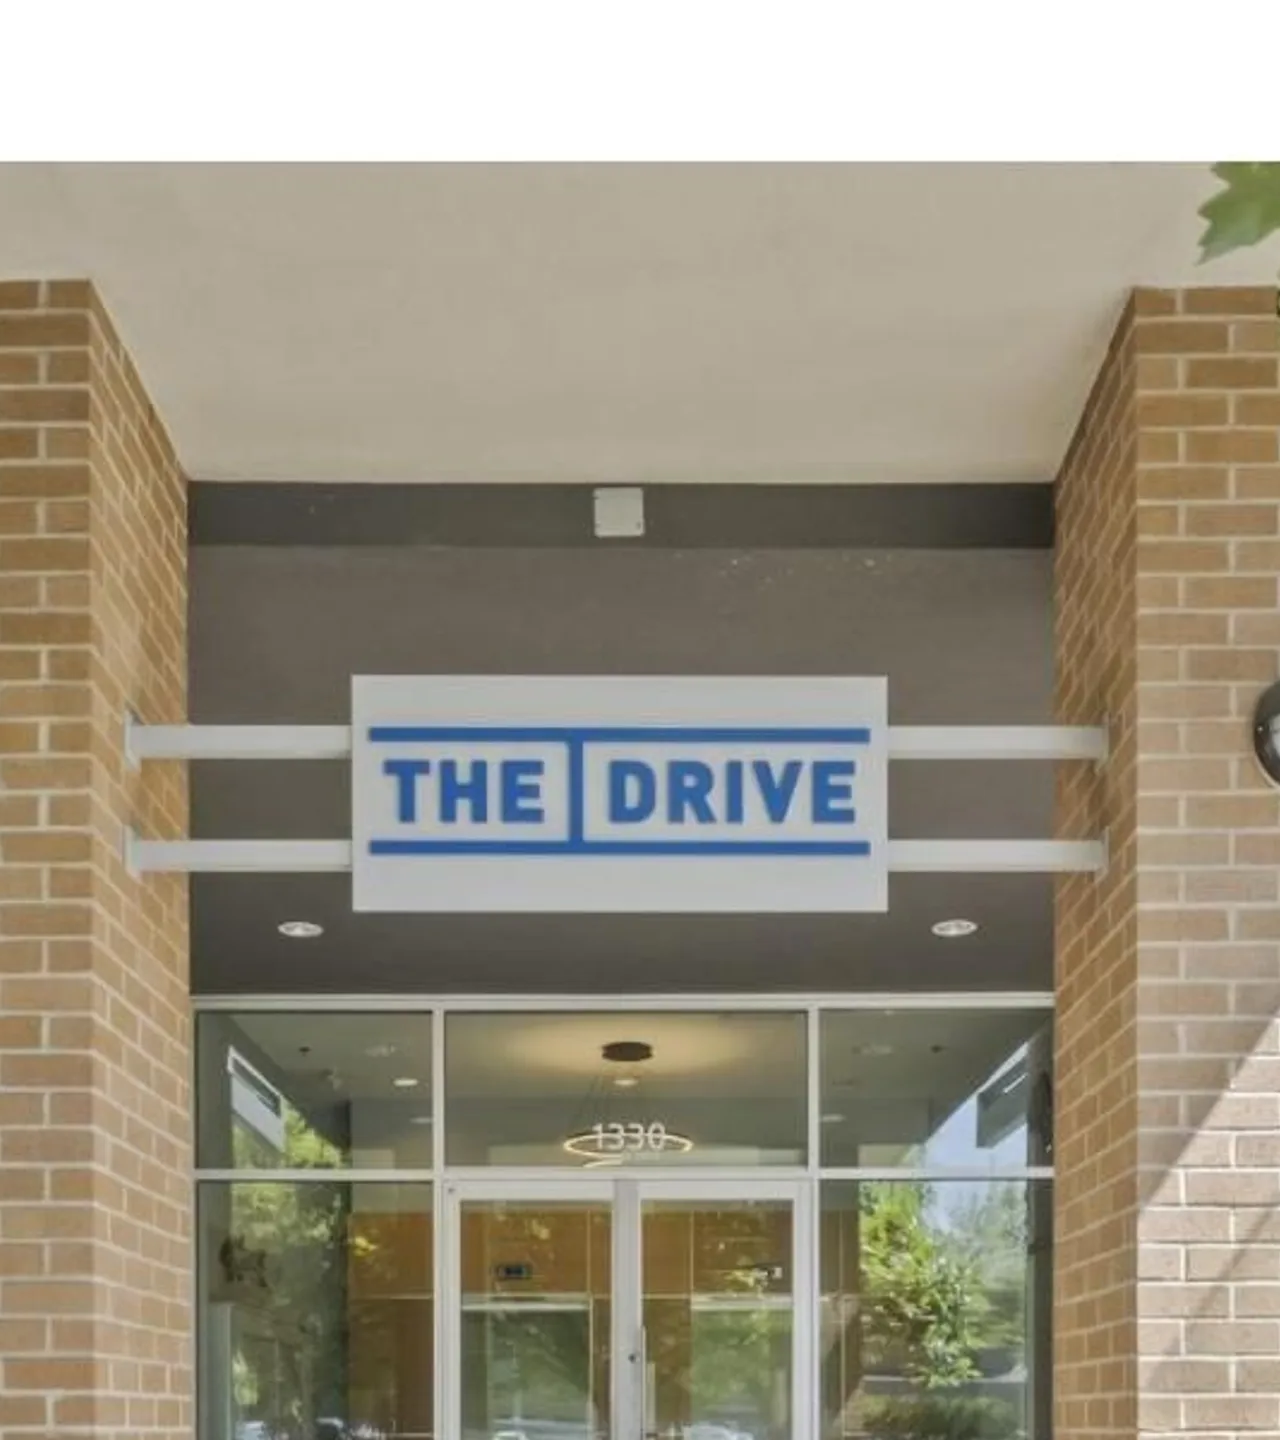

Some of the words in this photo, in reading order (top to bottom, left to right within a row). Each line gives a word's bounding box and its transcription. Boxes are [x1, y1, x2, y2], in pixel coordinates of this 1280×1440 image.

[383, 759, 545, 824] THE
[607, 759, 856, 824] DRIVE
[592, 1122, 666, 1150] 1330
